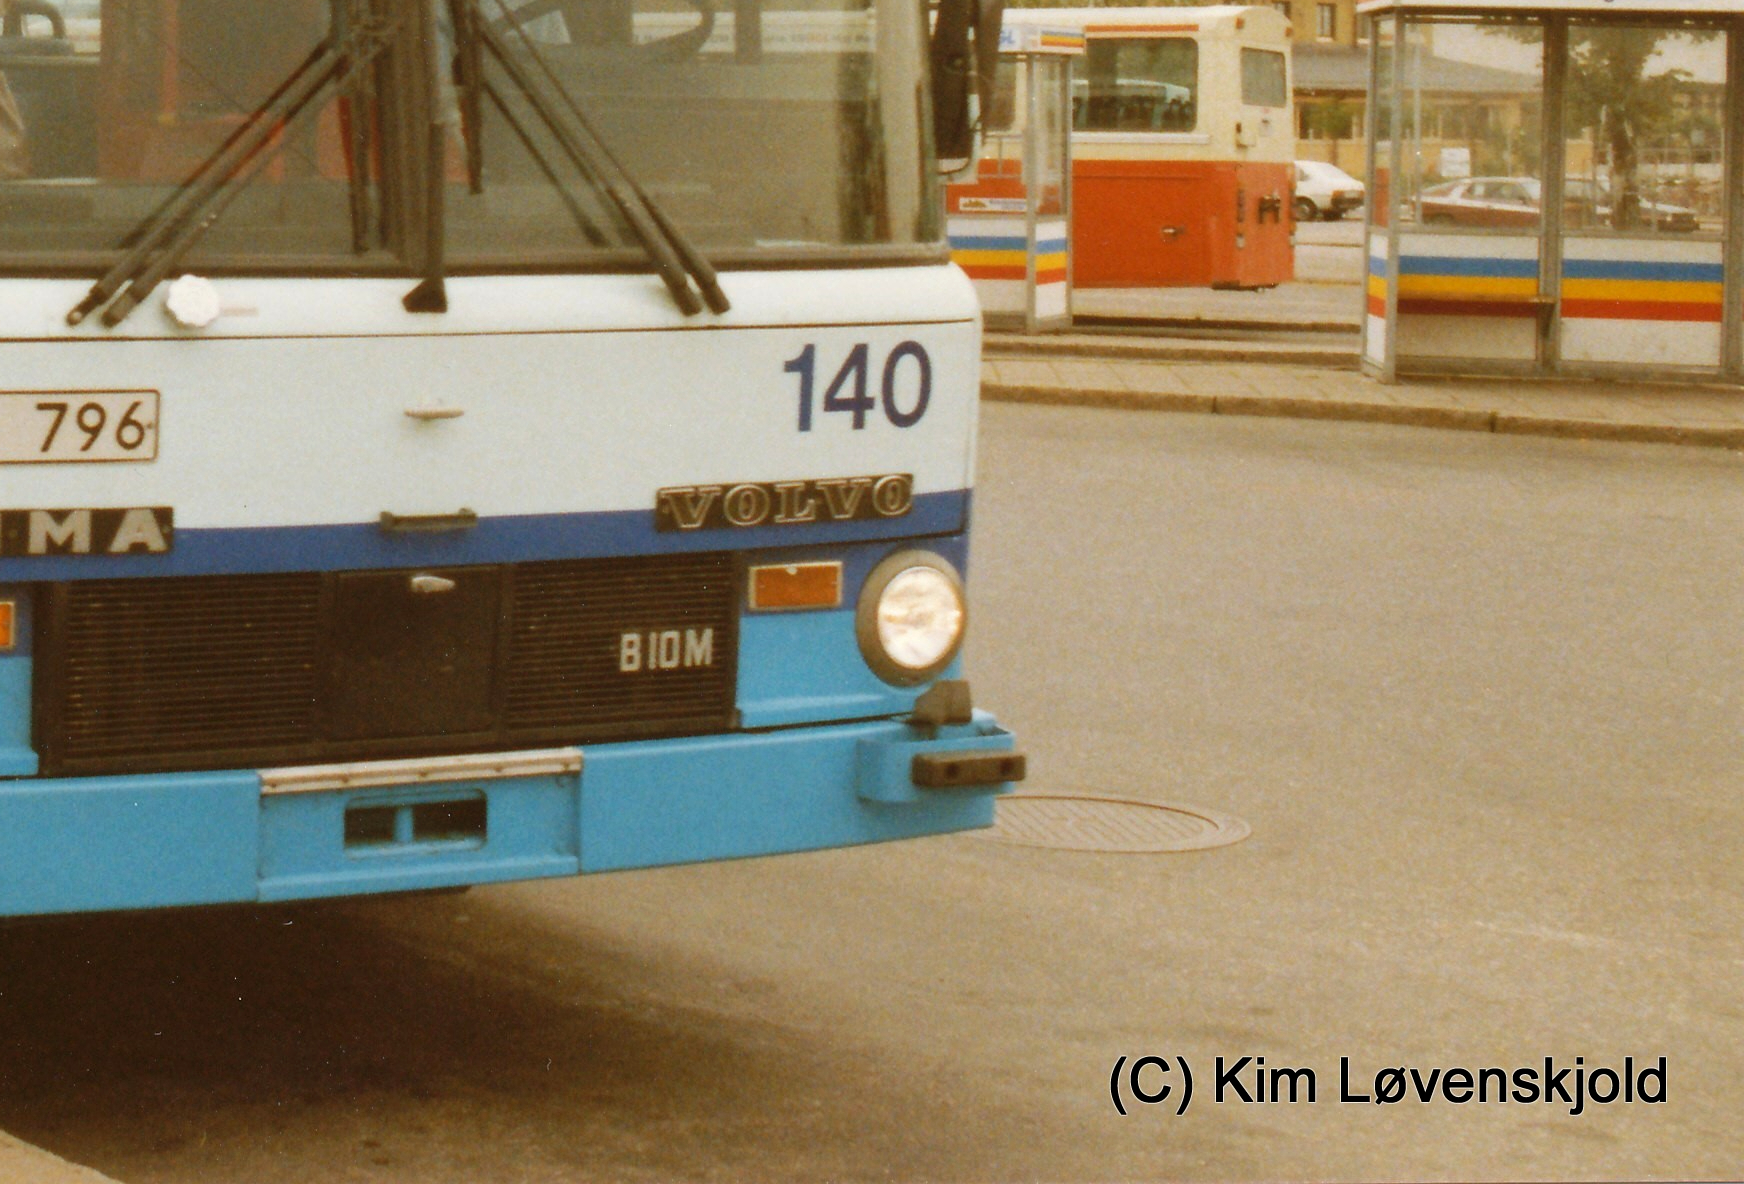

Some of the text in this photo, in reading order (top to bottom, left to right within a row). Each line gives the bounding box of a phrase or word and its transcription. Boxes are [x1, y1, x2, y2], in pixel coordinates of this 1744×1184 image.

[783, 340, 933, 433] 140
[35, 401, 146, 453] 796
[660, 473, 912, 529] VOLVO
